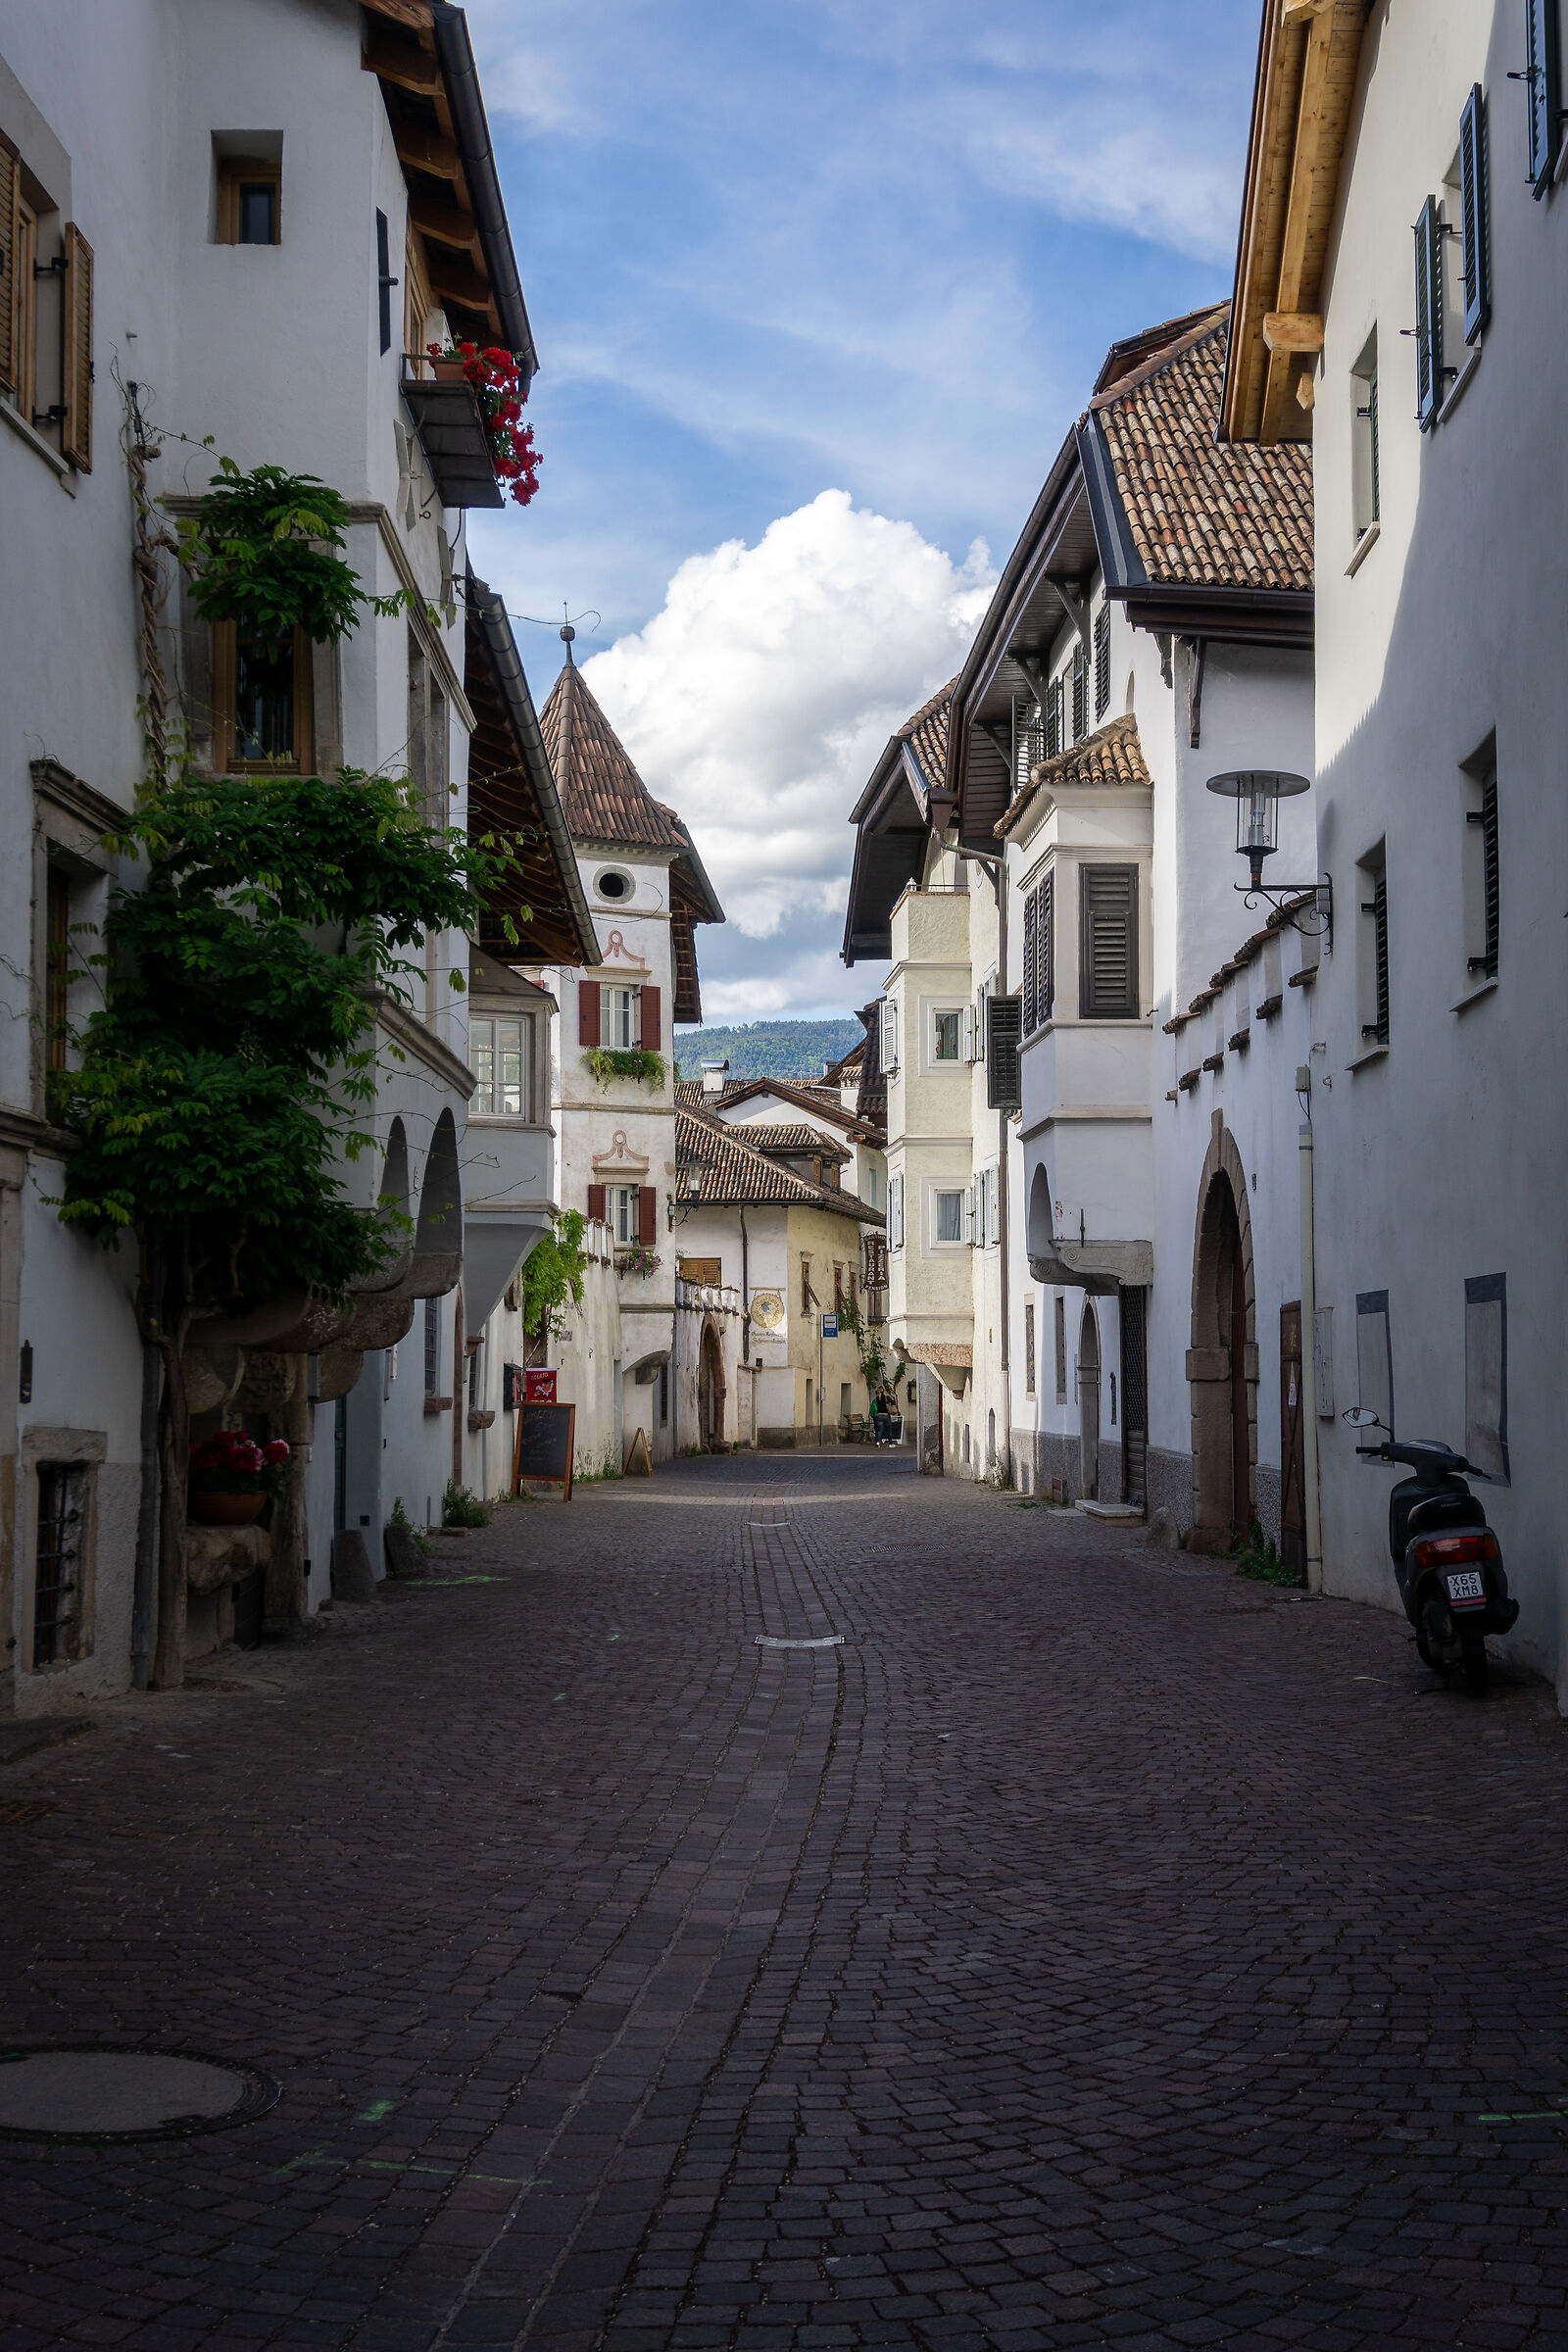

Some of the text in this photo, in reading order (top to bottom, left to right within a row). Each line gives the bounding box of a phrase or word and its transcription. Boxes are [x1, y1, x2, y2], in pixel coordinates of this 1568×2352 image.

[530, 1372, 549, 1381] GELATO
[1451, 1574, 1477, 1586] X65
[1453, 1585, 1479, 1596] XM8
